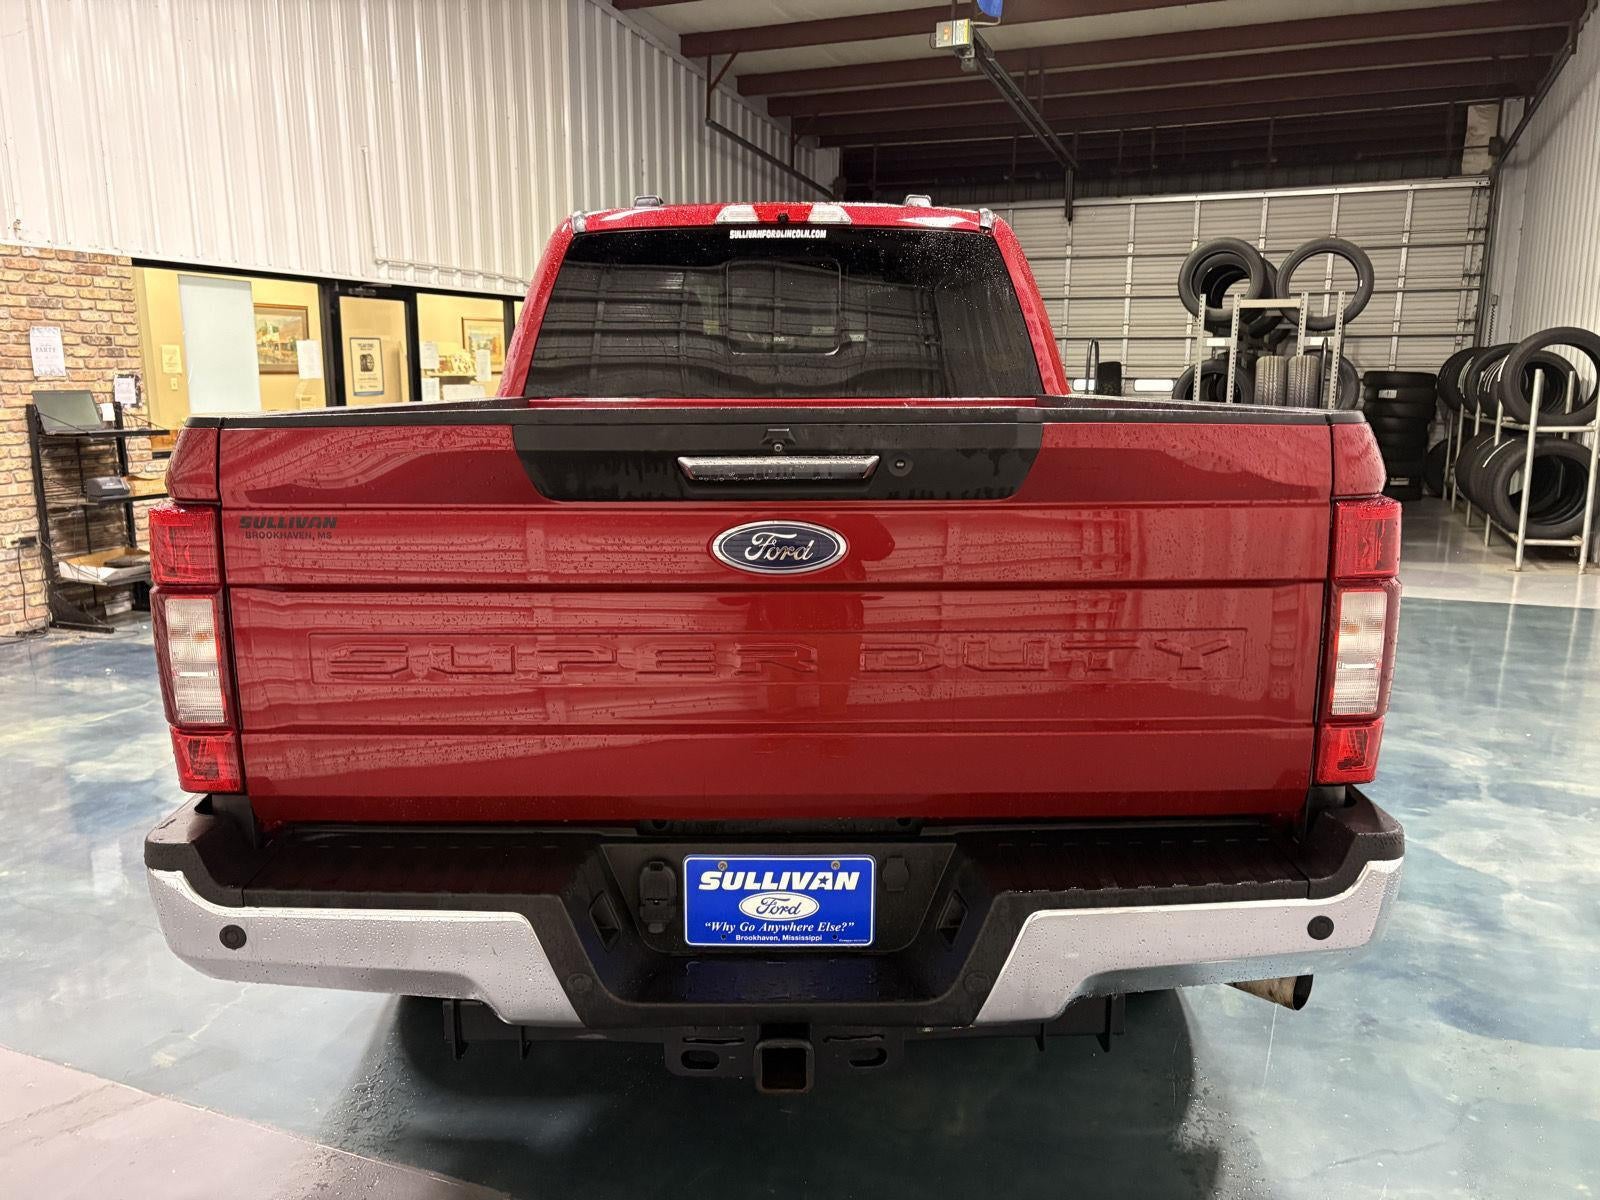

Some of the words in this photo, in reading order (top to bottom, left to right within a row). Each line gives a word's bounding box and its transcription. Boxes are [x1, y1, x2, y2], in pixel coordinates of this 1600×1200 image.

[729, 229, 827, 239] SULLIVANFORDLINCOLN.COM
[239, 515, 337, 528] SULLIVAN
[317, 531, 333, 540] MS
[744, 531, 815, 561] Ford
[327, 641, 818, 676] SUPER
[859, 637, 1231, 673] DUTY
[698, 871, 860, 891] SULLIVAN
[755, 896, 802, 916] Ford
[739, 921, 756, 932] Go
[759, 921, 814, 934] Anywhere
[735, 934, 781, 942] Brookhaven,
[782, 934, 823, 943] Mississippi
